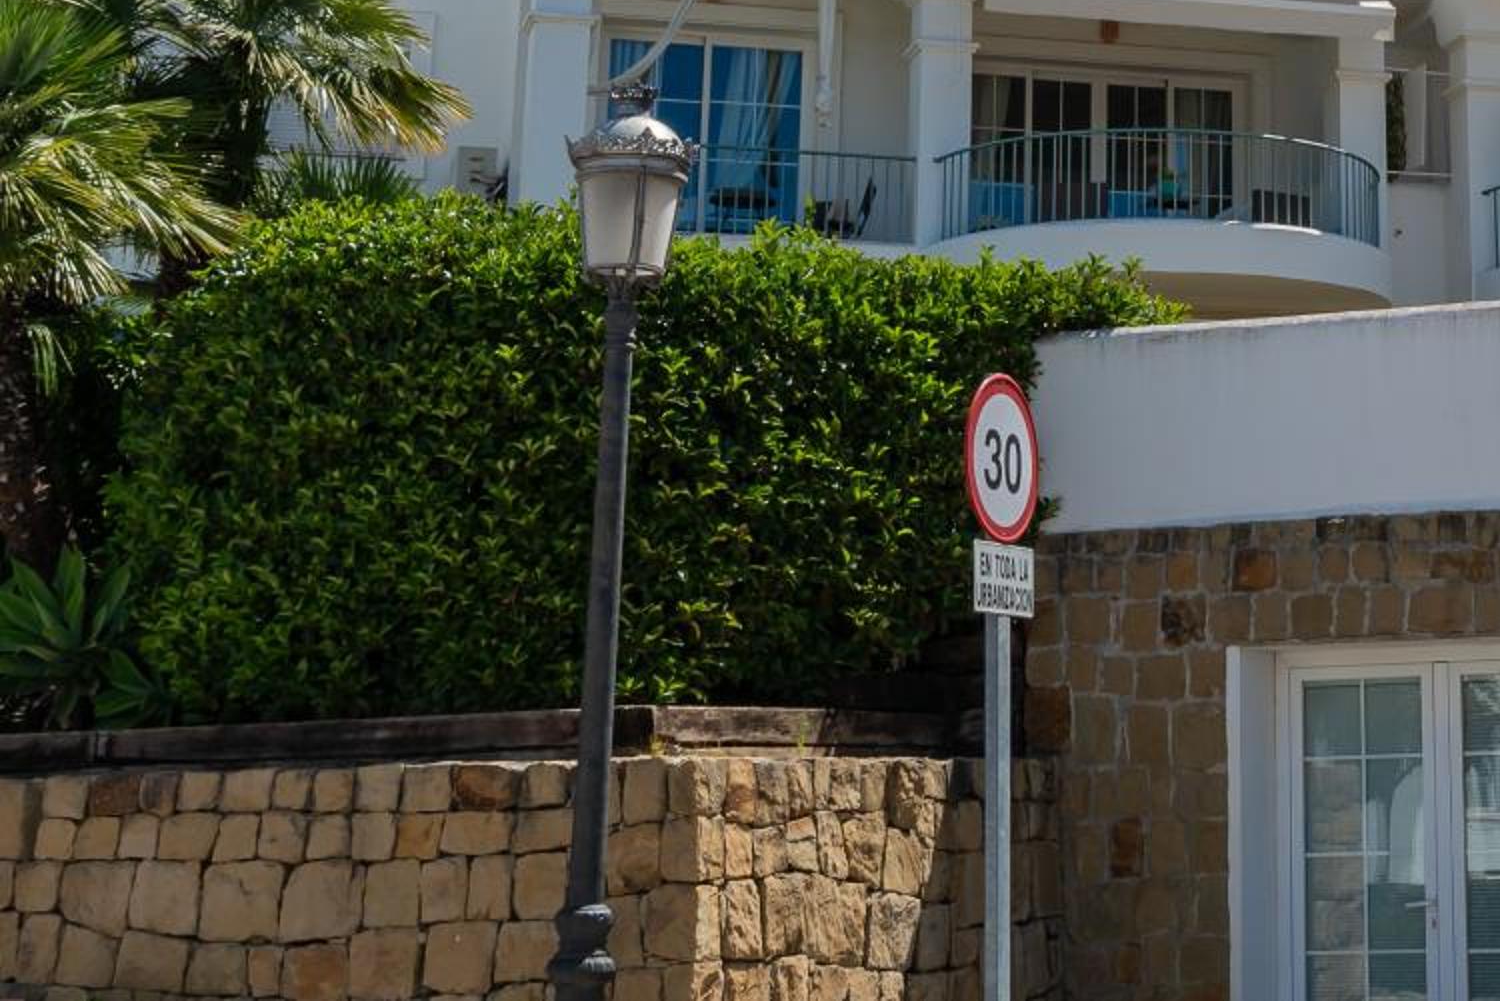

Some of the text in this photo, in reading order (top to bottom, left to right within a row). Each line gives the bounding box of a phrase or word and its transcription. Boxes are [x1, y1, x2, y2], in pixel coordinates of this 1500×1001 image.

[984, 429, 1022, 494] 30
[980, 552, 1029, 582] EN TODA LA
